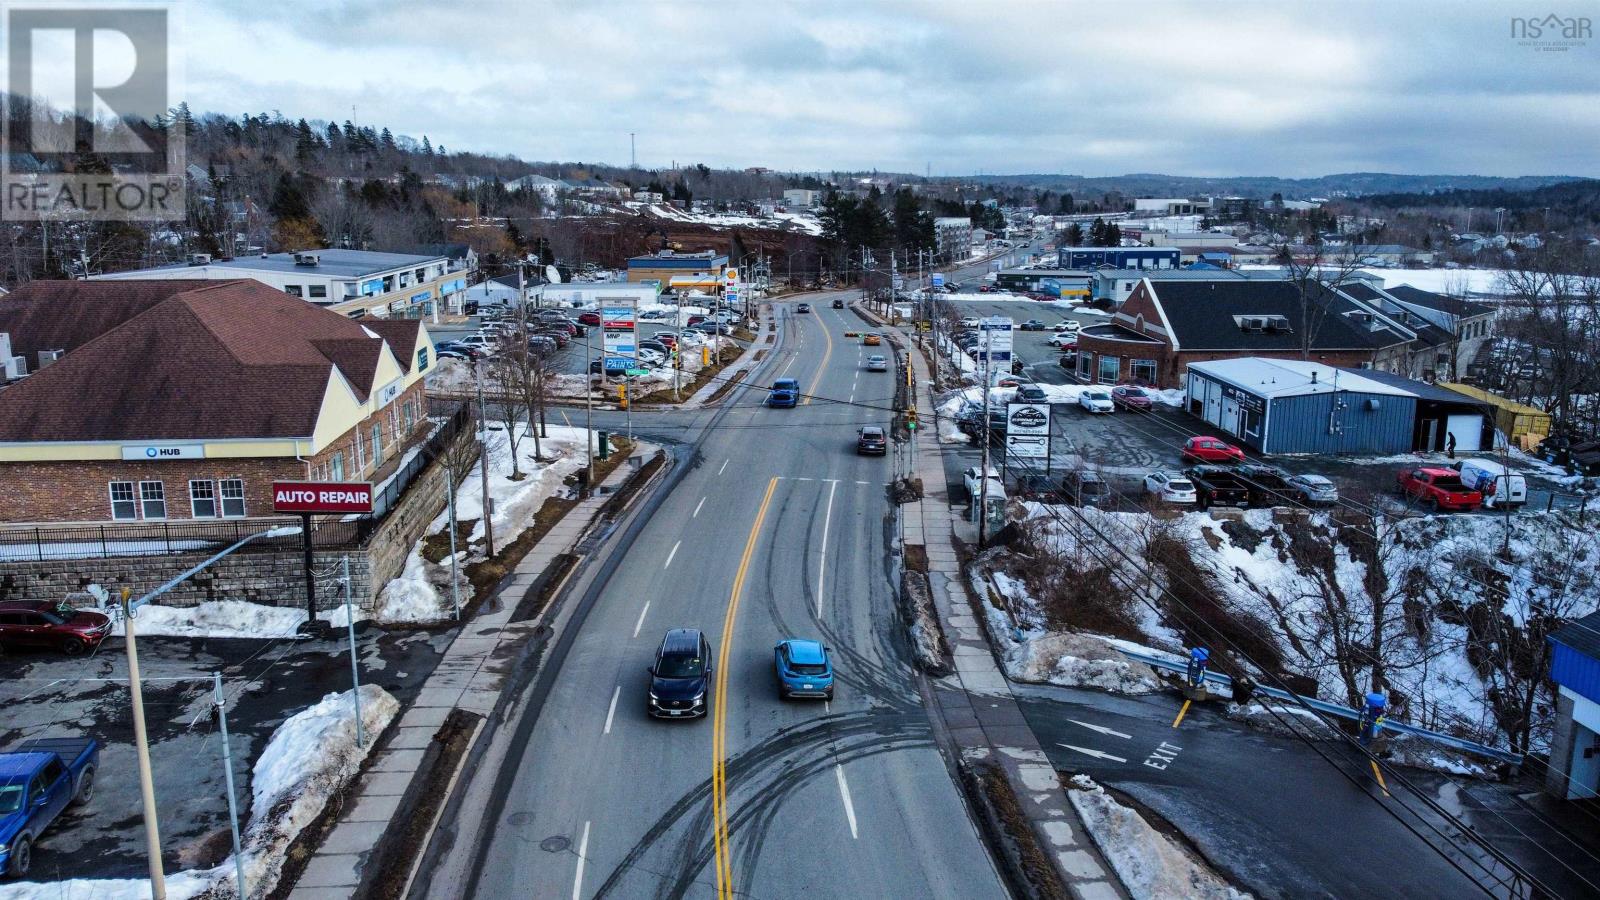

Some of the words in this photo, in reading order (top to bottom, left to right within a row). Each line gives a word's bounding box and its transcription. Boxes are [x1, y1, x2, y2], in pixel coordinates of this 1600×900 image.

[607, 359, 635, 369] PAINTS
[159, 448, 181, 456] HUB
[275, 491, 316, 503] AUTO
[319, 491, 370, 504] REPAIR
[1142, 741, 1184, 770] EXIT
